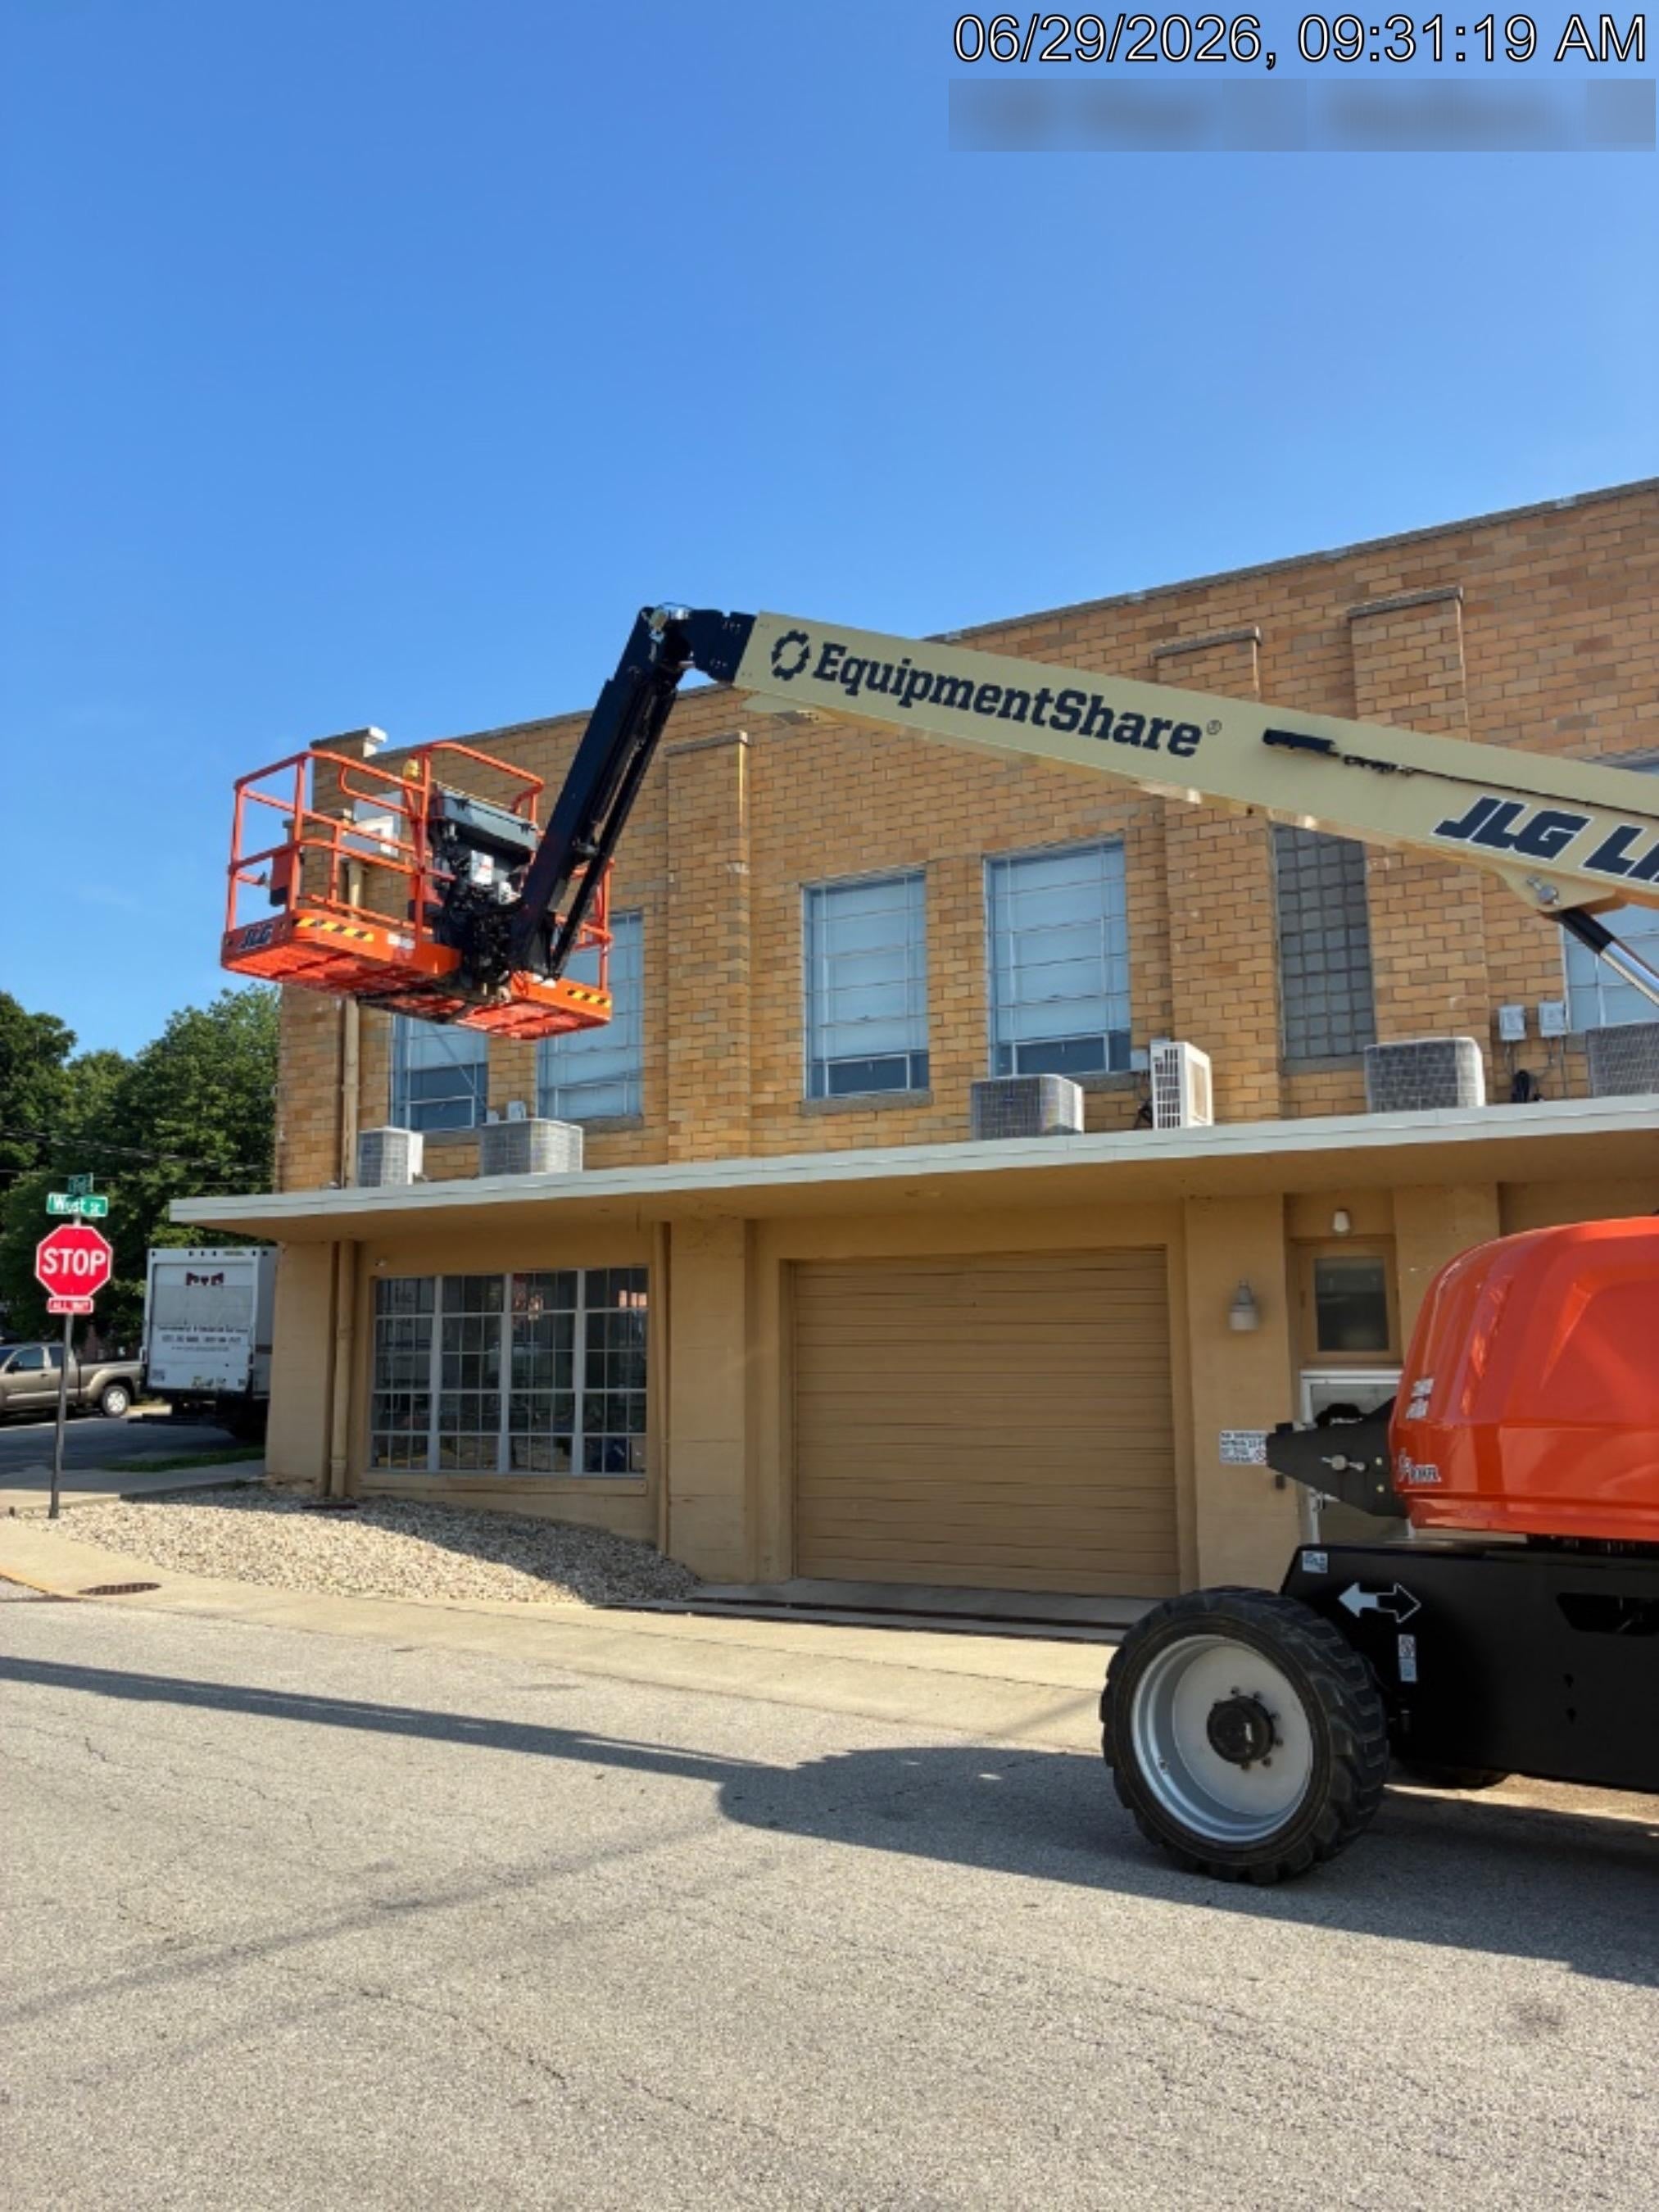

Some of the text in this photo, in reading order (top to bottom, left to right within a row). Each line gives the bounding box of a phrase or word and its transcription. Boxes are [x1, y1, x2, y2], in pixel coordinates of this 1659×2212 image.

[1433, 796, 1659, 886] JLG LI
[42, 1247, 107, 1276] STOP
